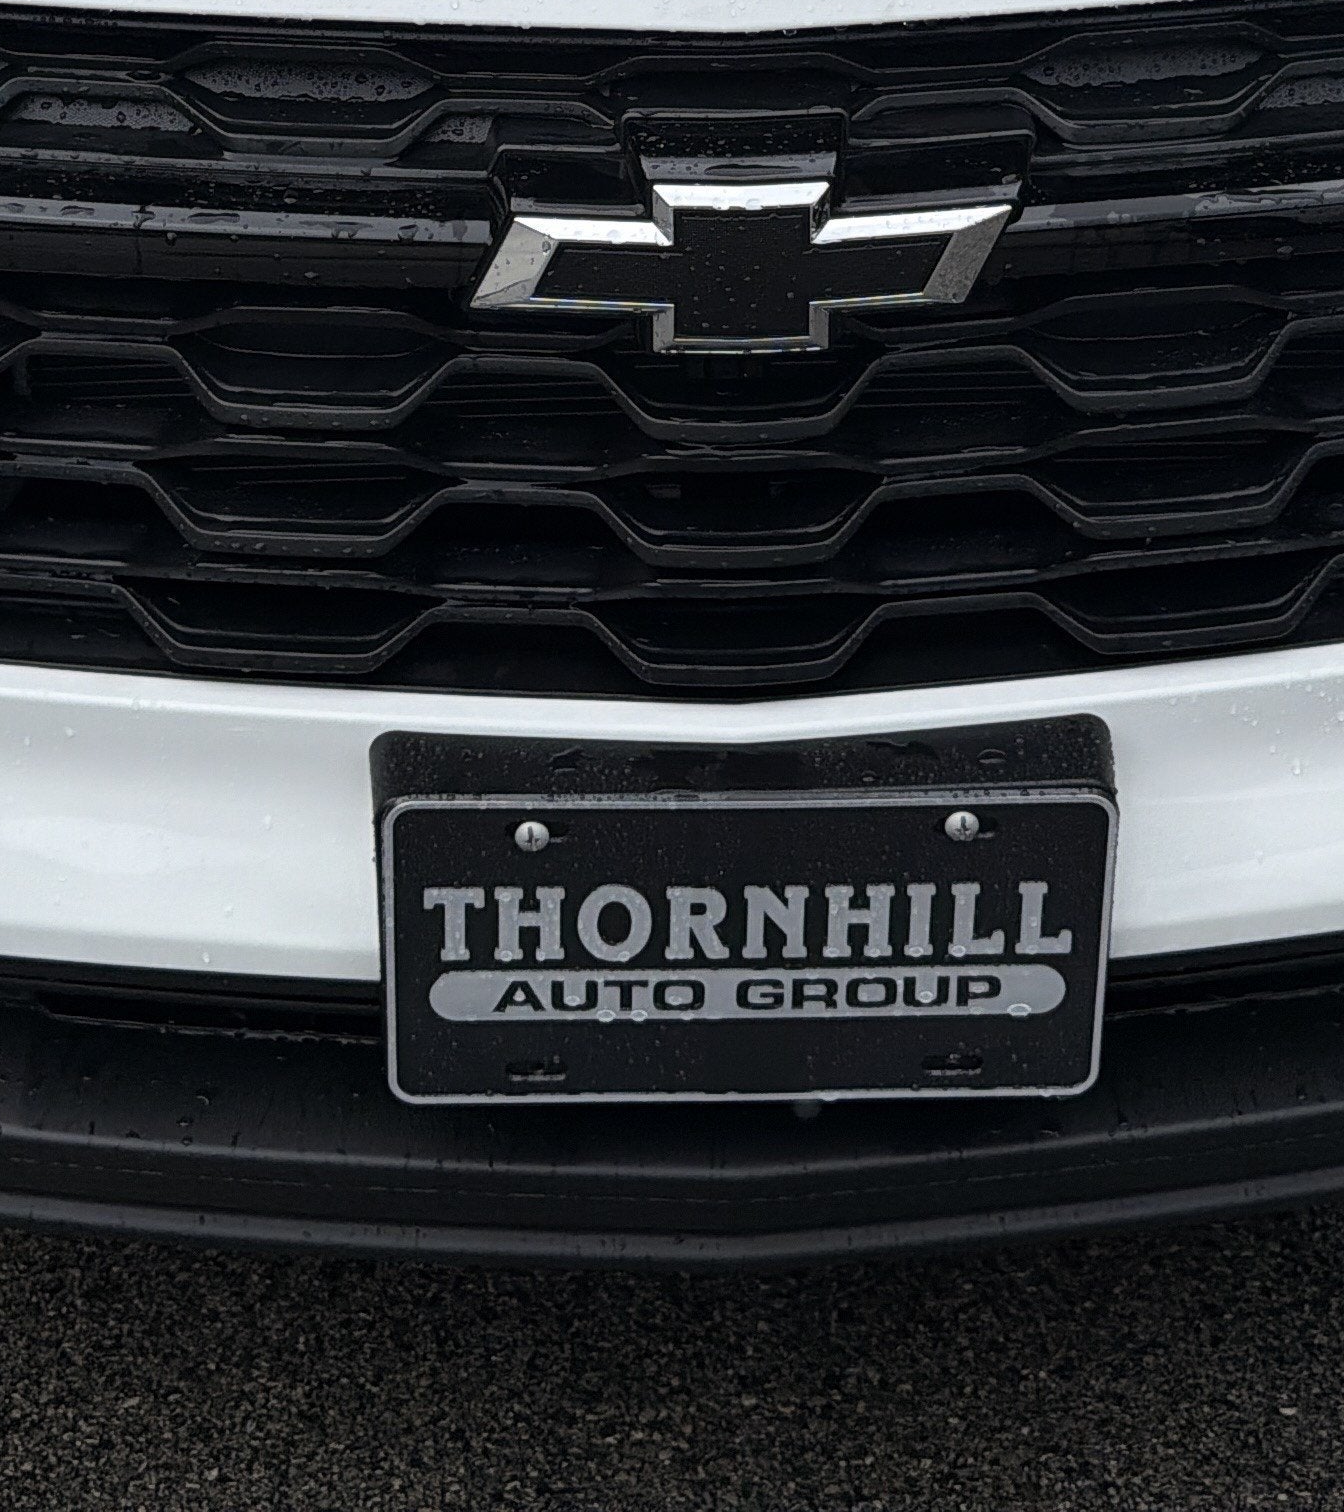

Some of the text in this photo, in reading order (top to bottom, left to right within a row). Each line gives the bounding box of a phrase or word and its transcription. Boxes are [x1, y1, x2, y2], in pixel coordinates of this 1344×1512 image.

[423, 880, 1073, 962] THORNHILL
[492, 974, 1002, 1013] AUTO GROUP
